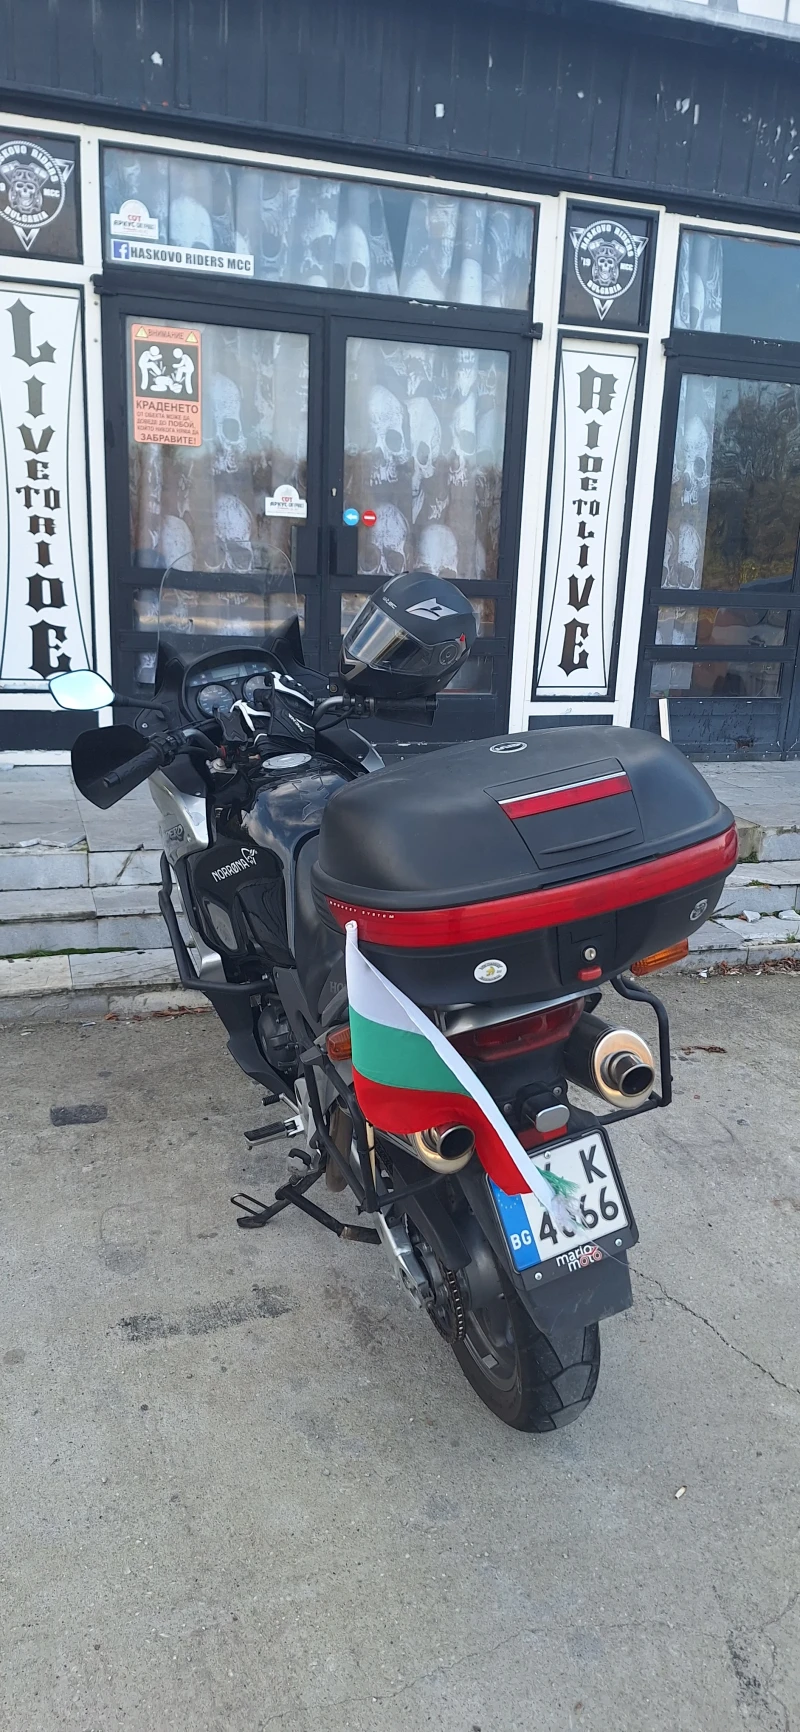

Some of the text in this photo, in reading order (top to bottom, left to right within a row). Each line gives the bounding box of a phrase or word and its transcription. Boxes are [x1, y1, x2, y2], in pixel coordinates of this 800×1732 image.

[0, 145, 59, 182] SKOVO RIDERS
[4, 205, 49, 223] BULGARIA
[580, 224, 634, 257] HASKOVO RIDERS
[130, 246, 182, 263] HASKOVO
[185, 253, 224, 268] RIDERS
[227, 259, 251, 271] MCC
[586, 279, 622, 295] BULGARIA
[148, 328, 184, 340] ВНИМАНИЕ
[136, 400, 199, 414] КРАДЕНЕТО
[140, 432, 197, 445] ЗАБРАВИТЕ!
[5, 297, 72, 679] LIVE TO RIDE
[557, 364, 619, 677] RIDE TO LIVE
[211, 858, 250, 883] NORRØNA
[361, 910, 395, 919] SYSTEM
[579, 1144, 608, 1184] K
[510, 1229, 532, 1251] BG
[567, 1250, 602, 1272] moto
